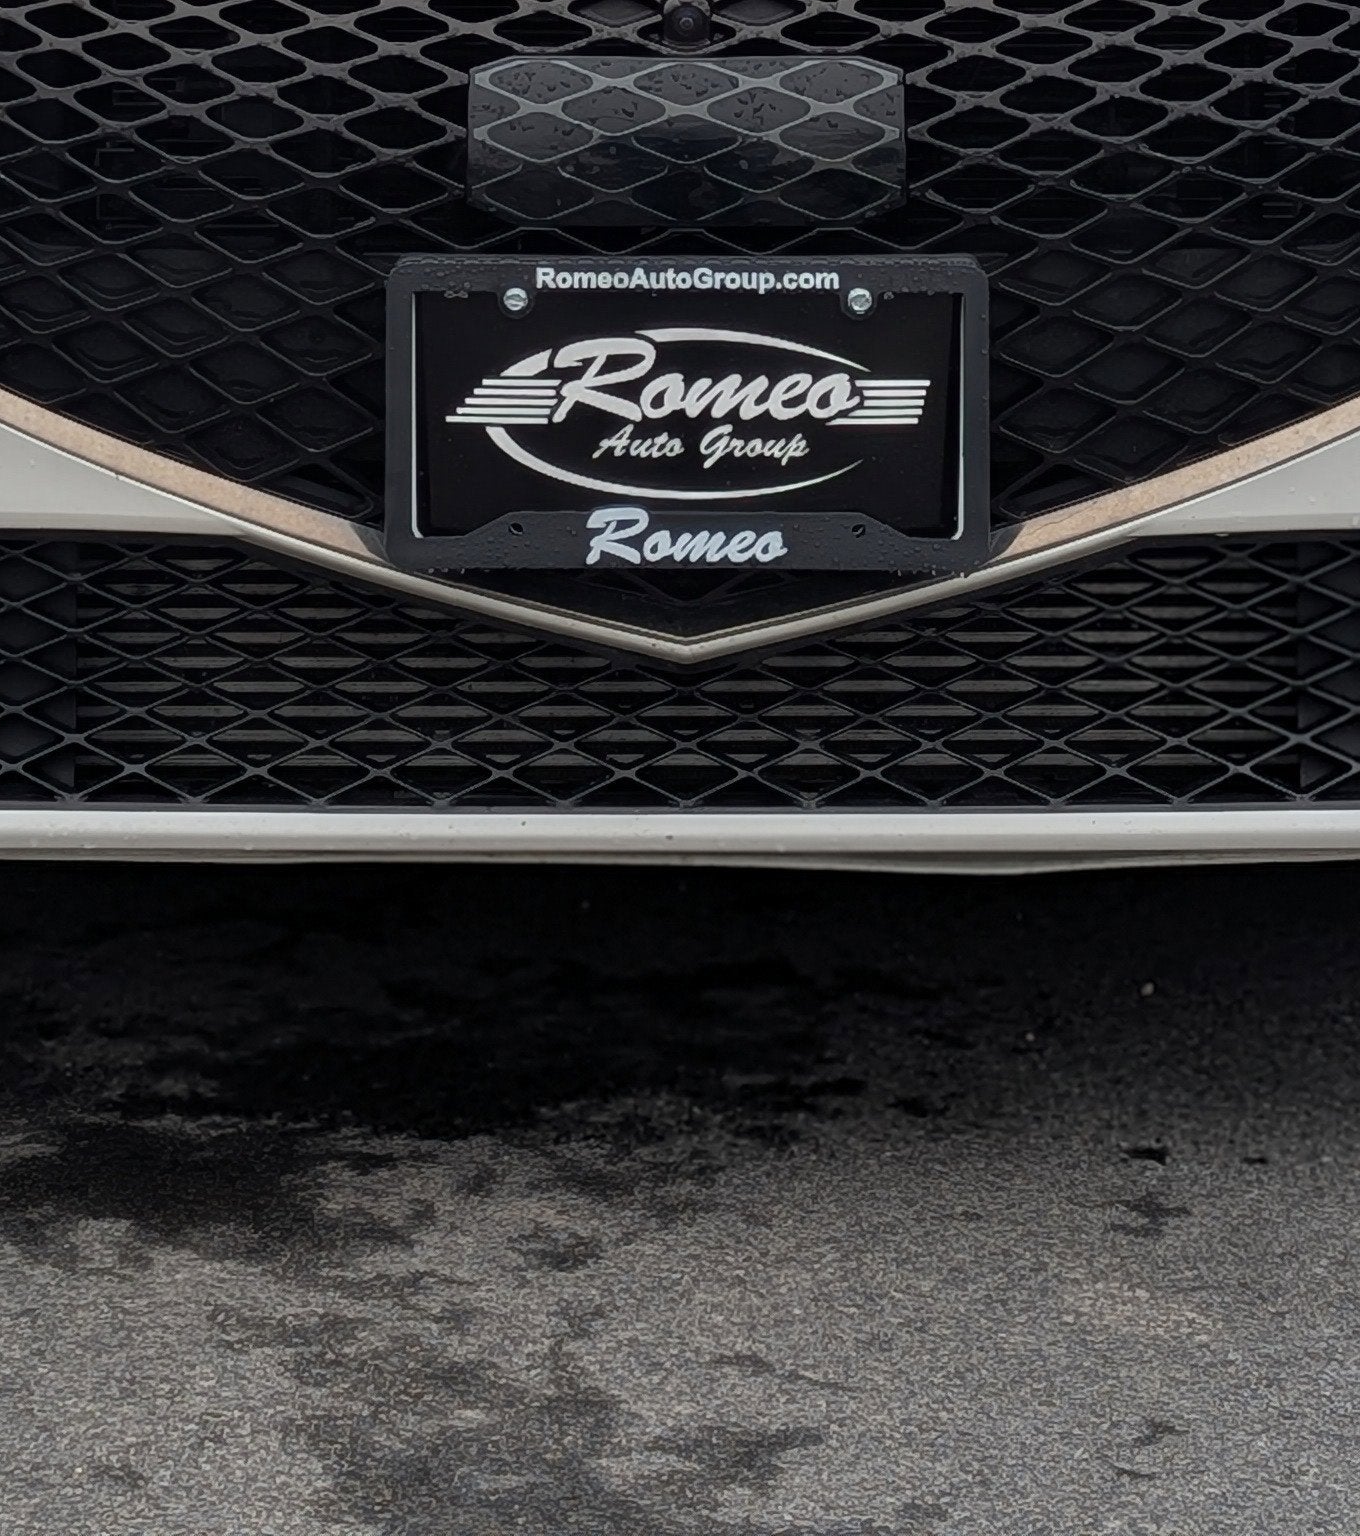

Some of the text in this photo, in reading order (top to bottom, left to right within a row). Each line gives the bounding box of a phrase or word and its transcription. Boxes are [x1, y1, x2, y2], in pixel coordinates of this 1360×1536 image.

[535, 267, 840, 295] RomeoAutoGroup.com
[552, 337, 861, 424] Romeo
[592, 423, 811, 469] Auto Group
[585, 506, 789, 565] Romeo
